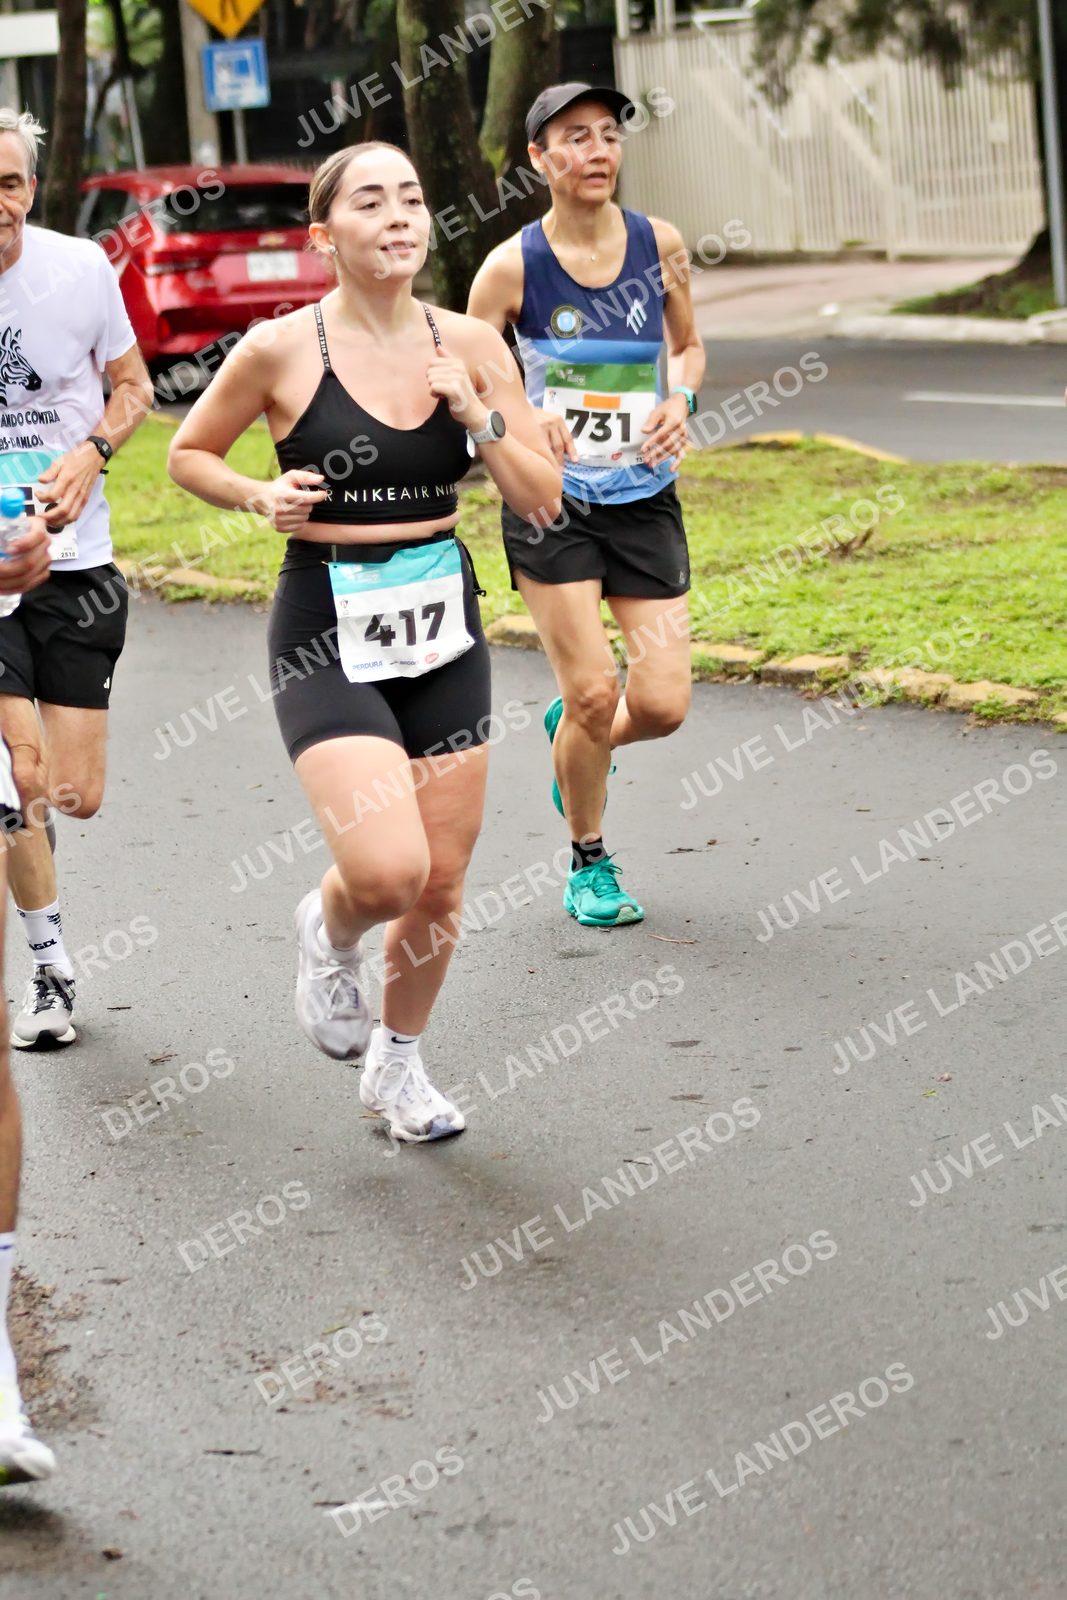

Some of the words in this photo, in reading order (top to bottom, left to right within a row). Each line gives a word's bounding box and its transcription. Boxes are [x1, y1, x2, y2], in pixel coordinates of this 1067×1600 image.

[25, 408, 61, 426] CONTRA
[565, 408, 631, 443] 731
[364, 601, 446, 647] 417
